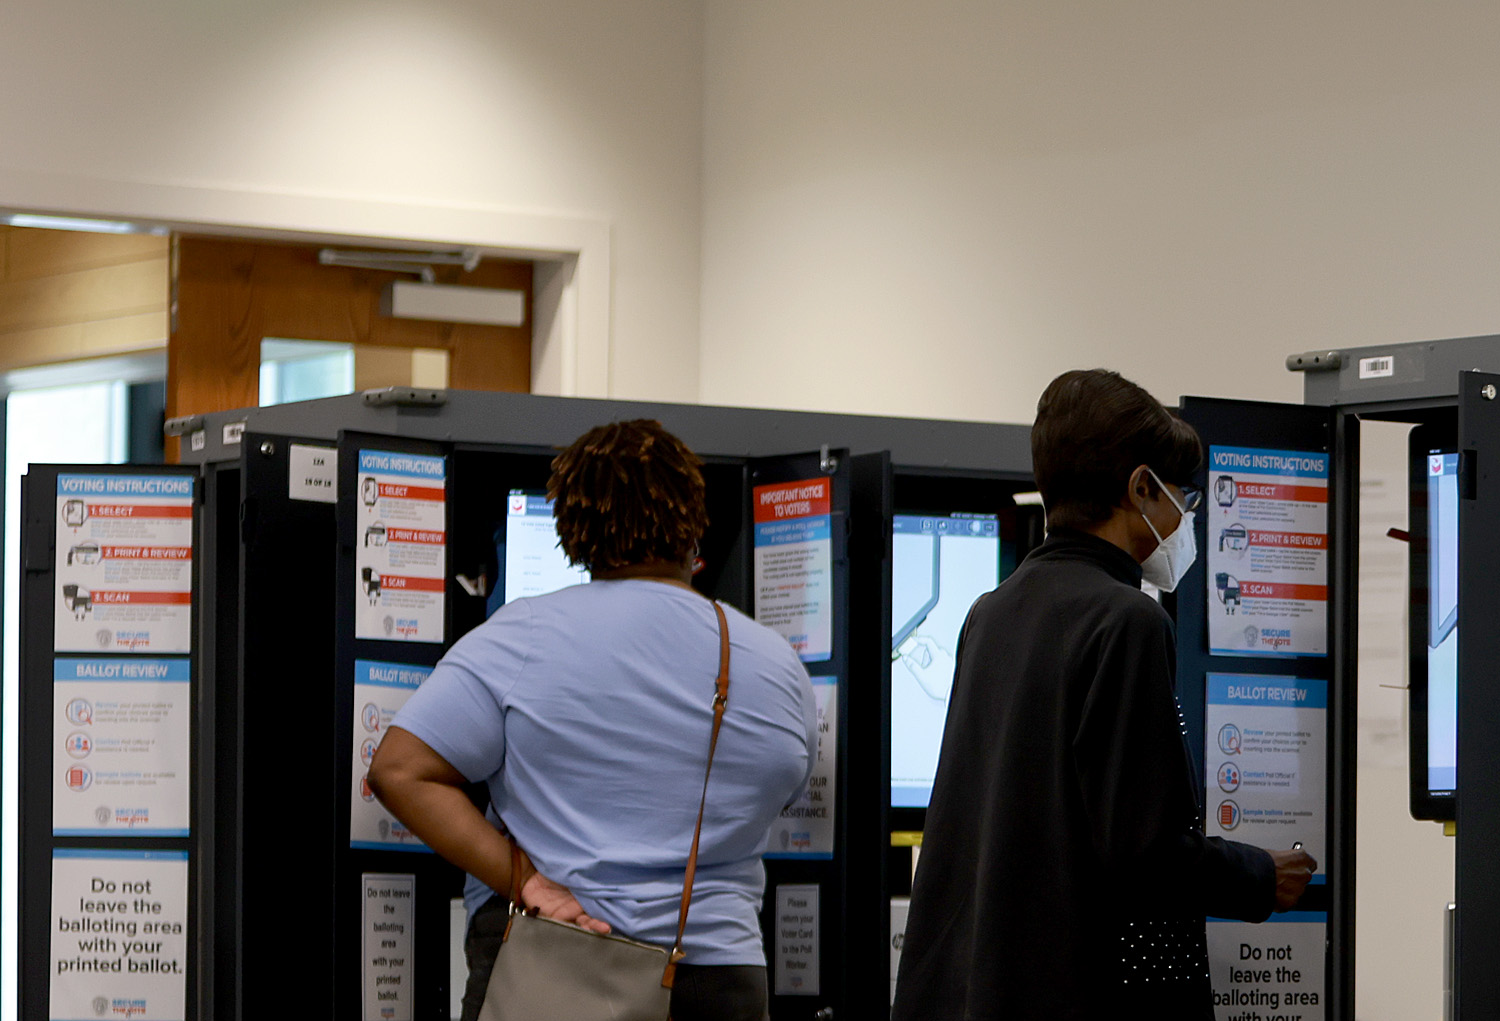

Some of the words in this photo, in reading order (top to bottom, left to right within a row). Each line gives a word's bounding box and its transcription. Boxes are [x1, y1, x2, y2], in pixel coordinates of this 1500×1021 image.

[361, 455, 389, 470] VOTING
[389, 458, 443, 475] INSTRUCTIONS
[1213, 451, 1251, 467] VOTING
[1252, 455, 1325, 473] INSTRUCTIONS
[61, 478, 104, 492] VOTING
[107, 479, 190, 494] INSTRUCTIONS
[384, 485, 408, 496] SELECT
[1238, 485, 1245, 494] 1.
[1245, 485, 1276, 497] SELECT
[760, 488, 798, 505] IMPORTANT
[799, 484, 824, 499] NOTICE
[99, 507, 133, 516] SELECT
[774, 504, 784, 517] TO
[784, 501, 811, 516] VOTERS
[395, 531, 413, 541] PRINT
[418, 532, 443, 543] REVIEW
[1251, 533, 1258, 543] 2.
[1259, 533, 1283, 545] PRINT
[1283, 535, 1289, 544] &
[1290, 535, 1323, 546] REVIEW
[114, 549, 140, 557] PRINT
[151, 550, 187, 558] REVIEW
[388, 578, 406, 588] SCAN
[1242, 585, 1249, 594] 3.
[1249, 584, 1273, 595] SCAN
[103, 594, 130, 602] SCAN
[1261, 628, 1291, 638] SECURE
[76, 664, 120, 677] BALLOT
[122, 664, 169, 678] REVIEW
[369, 667, 399, 682] BALLOT
[1227, 685, 1266, 699] BALLOT
[1267, 688, 1307, 702] REVIEW
[91, 877, 116, 894] Do
[122, 879, 152, 894] not
[367, 888, 377, 898] Do
[379, 888, 391, 898] not
[392, 889, 410, 899] leave
[80, 898, 127, 913] leave
[134, 899, 162, 914] the
[383, 904, 395, 914] the
[787, 898, 807, 908] Please
[800, 915, 814, 924] your
[59, 917, 137, 937] balloting
[143, 922, 182, 935] area
[373, 922, 404, 935] balloting
[798, 929, 813, 938] Card
[78, 937, 116, 952] with
[123, 941, 163, 957] your
[381, 939, 397, 948] area
[789, 945, 799, 954] the
[1240, 943, 1262, 960] Do
[1266, 944, 1292, 961] not
[58, 957, 121, 976] printed
[128, 958, 183, 974] ballot.
[372, 957, 387, 966] with
[389, 958, 405, 968] your
[376, 975, 401, 986] printed
[1229, 966, 1272, 983] leave
[1275, 966, 1301, 983] the
[1212, 989, 1280, 1010] balloting
[1284, 992, 1319, 1006] area
